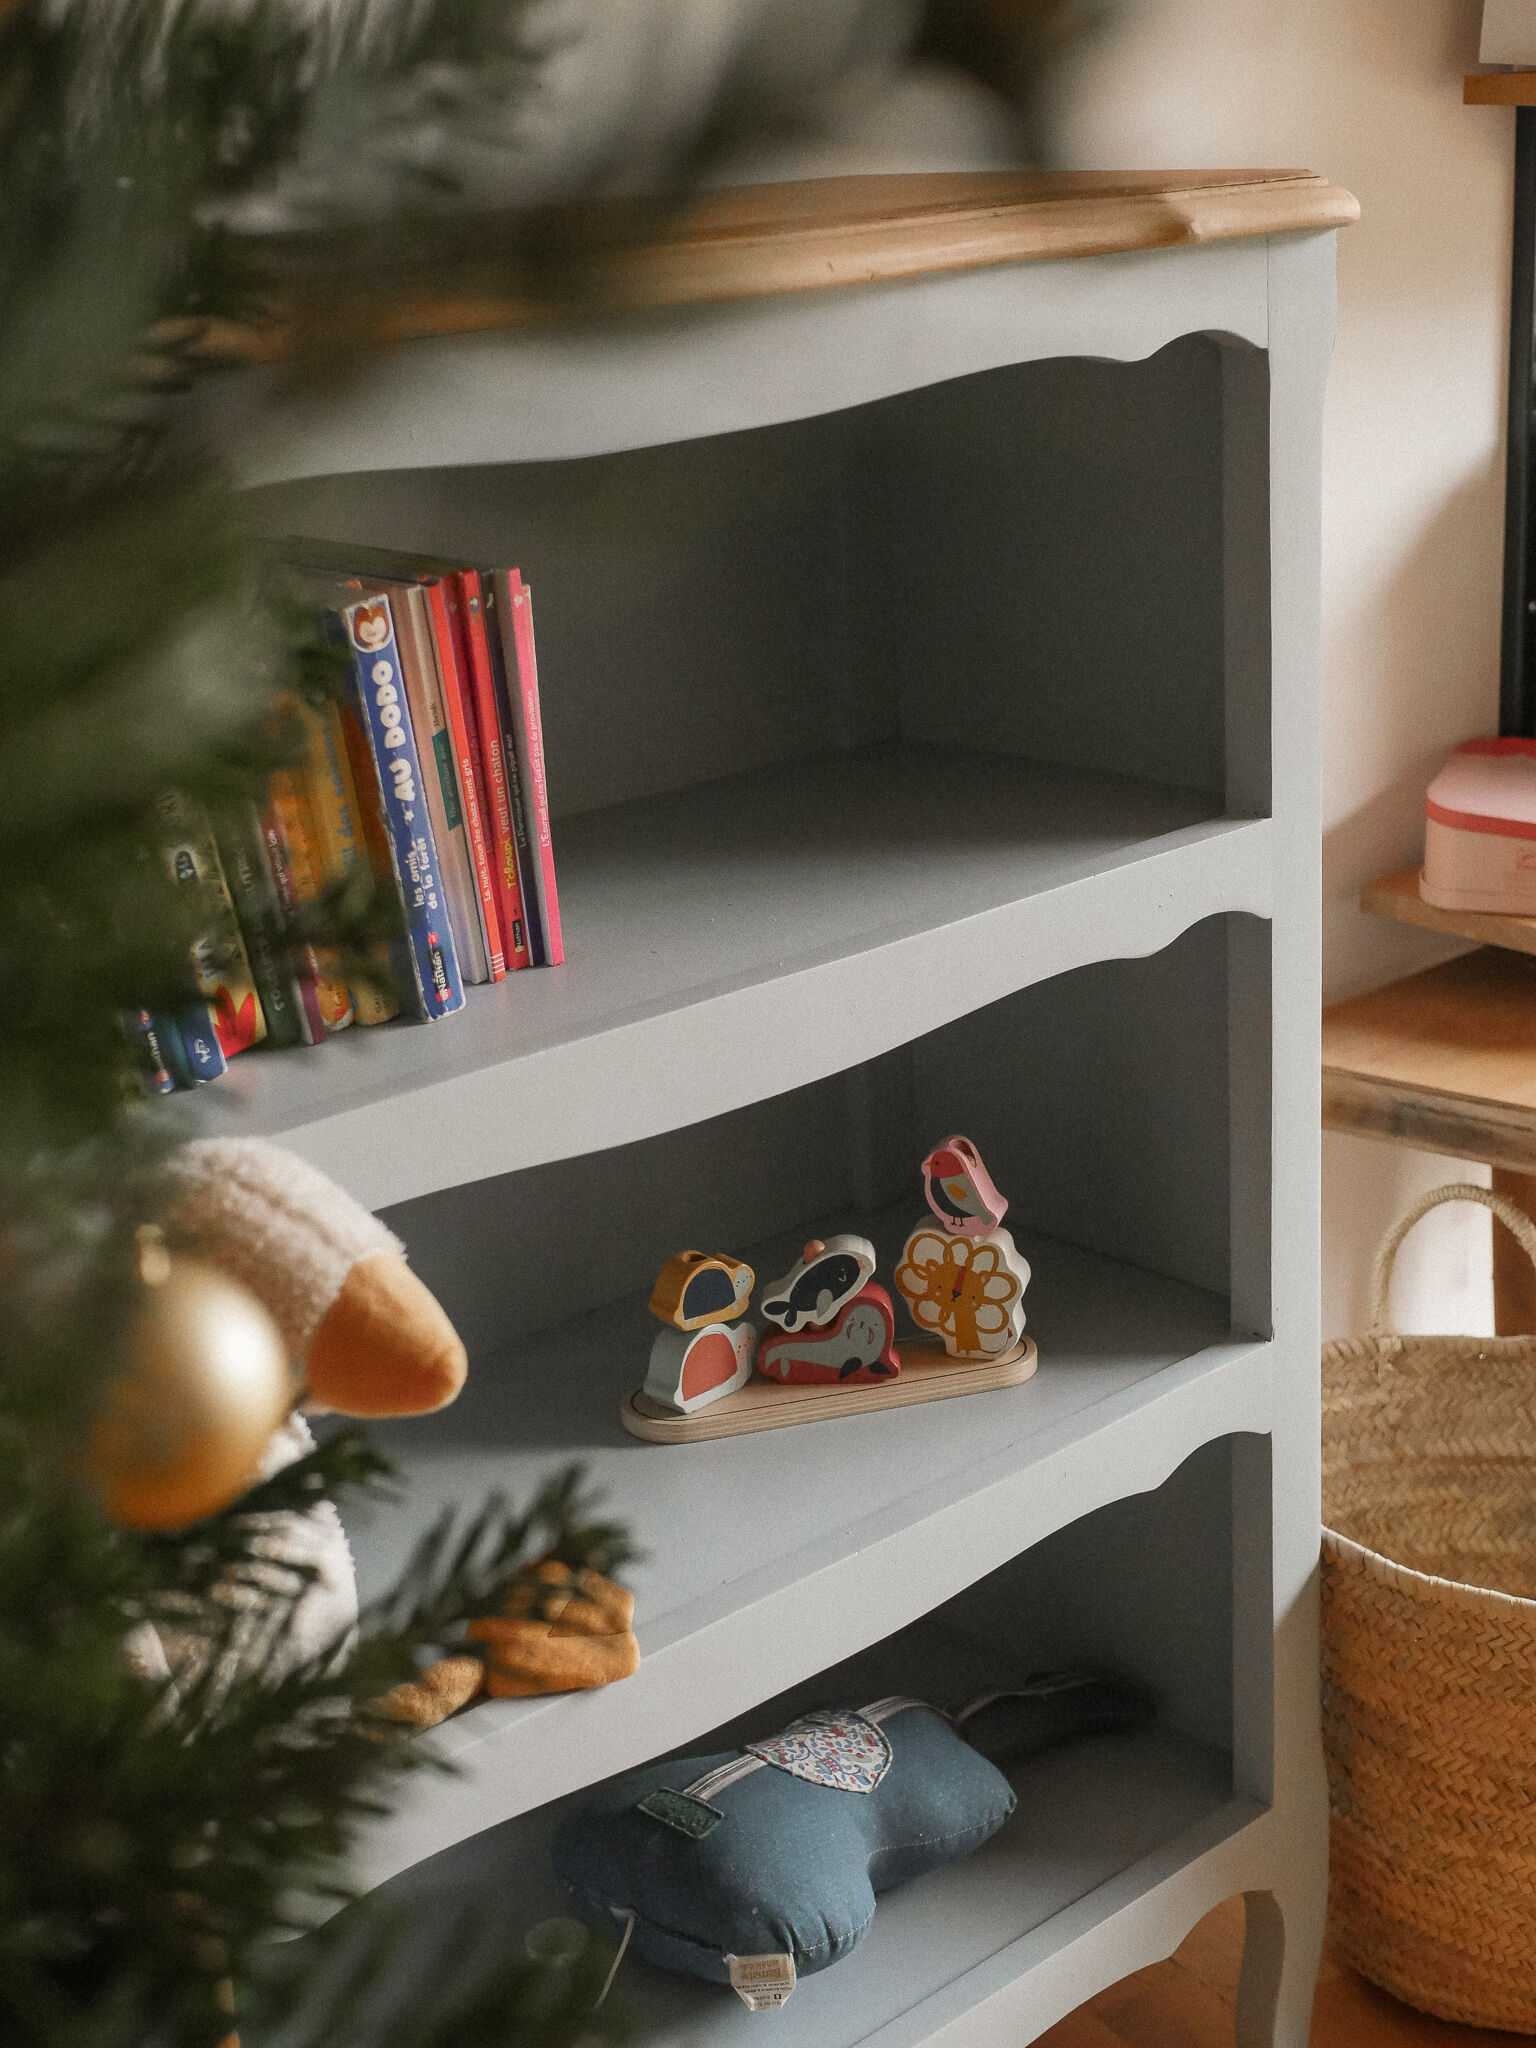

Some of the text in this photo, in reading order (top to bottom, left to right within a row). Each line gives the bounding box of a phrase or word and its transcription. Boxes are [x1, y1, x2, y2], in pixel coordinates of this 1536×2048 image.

[527, 691, 540, 731] provisions
[371, 659, 416, 801] AU DODO
[531, 732, 538, 741] de
[534, 743, 543, 758] pas
[463, 758, 473, 777] gris
[490, 740, 504, 783] chaton
[465, 777, 475, 799] sont
[496, 787, 506, 803] un
[538, 794, 548, 807] qui
[469, 801, 479, 826] chats
[497, 808, 510, 834] veut
[472, 829, 482, 844] les
[477, 847, 487, 866] tous
[405, 850, 424, 908] les amis
[422, 874, 433, 890] la
[427, 892, 438, 910] de
[431, 951, 447, 995] Nathan
